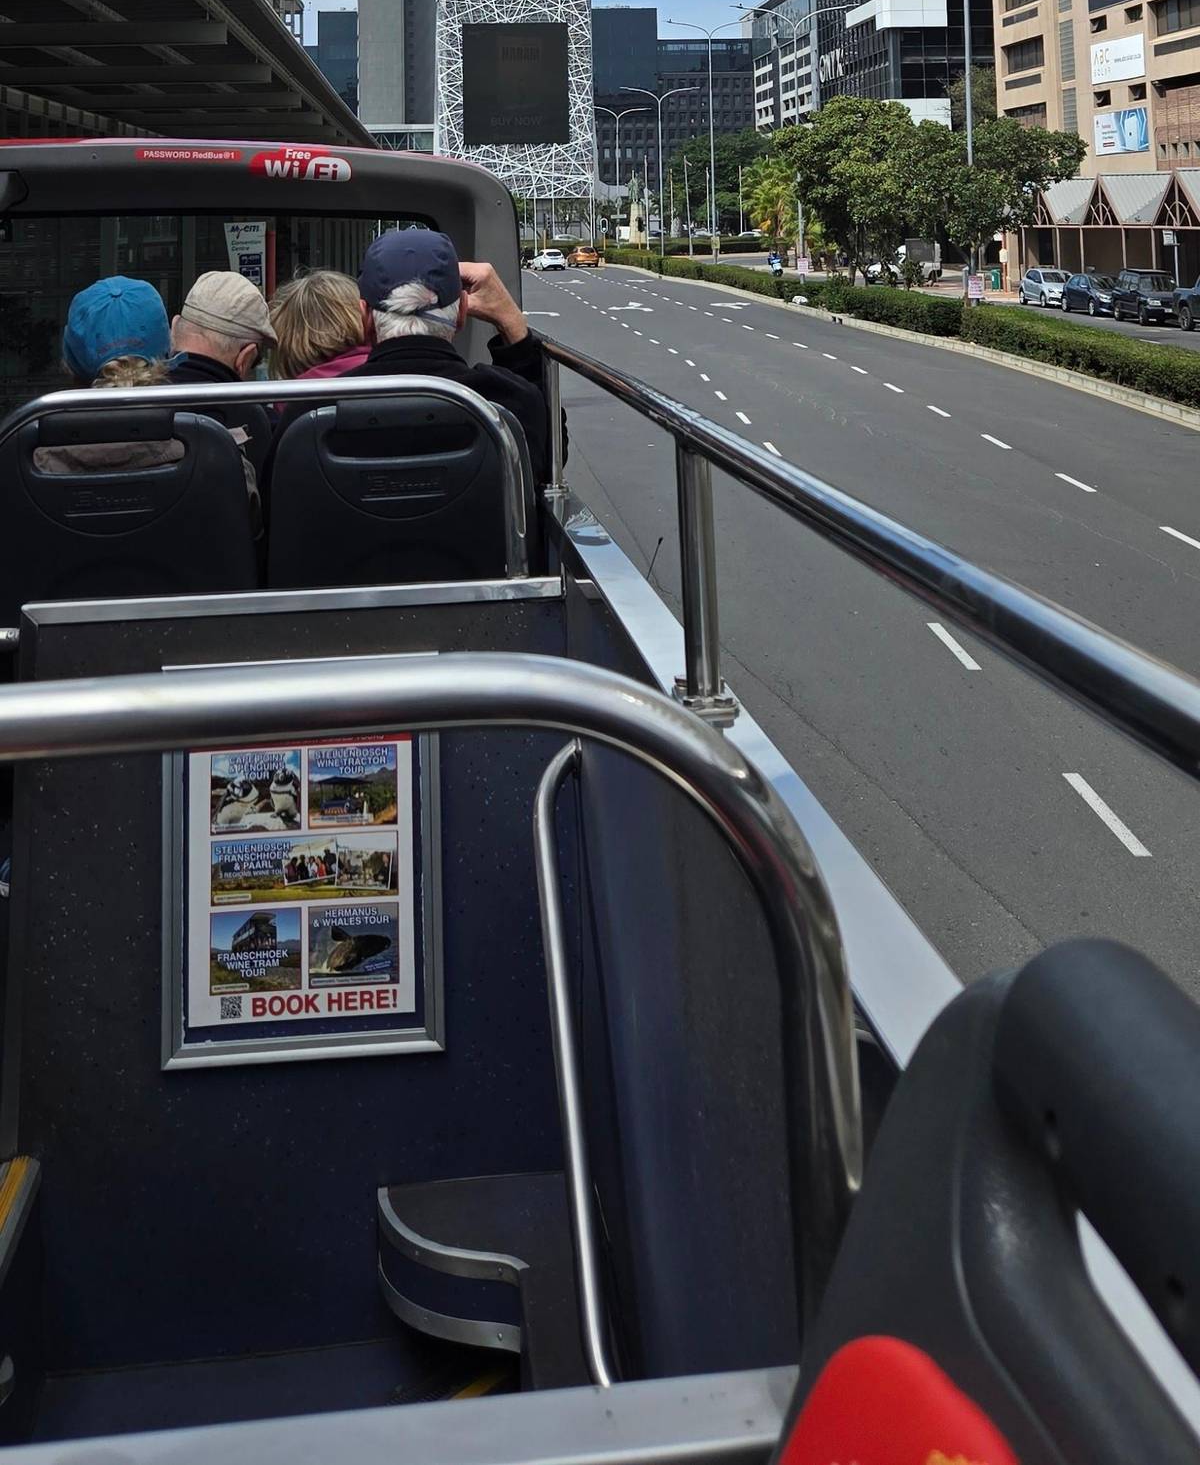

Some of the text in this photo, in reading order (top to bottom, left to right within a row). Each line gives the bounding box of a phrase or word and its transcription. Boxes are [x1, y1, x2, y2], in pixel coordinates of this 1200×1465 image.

[1094, 48, 1110, 66] ABC
[143, 150, 235, 159] PASSWORD RedBus@1
[285, 148, 311, 160] Free
[315, 747, 388, 759] STELLENBOSCH
[317, 756, 386, 768] WINE TRACTOR
[244, 771, 270, 781] TOUR
[339, 765, 366, 775] TOUR
[215, 842, 290, 855] STELLENBOSCH
[219, 850, 289, 863] FRANSCHHOEK
[233, 860, 273, 871] & PAARL
[325, 907, 377, 918] HERMANUS
[313, 915, 390, 928] & WHALES TOUR
[217, 949, 289, 962] FRANSCHHOEK
[226, 959, 280, 971] WINE TRAM
[240, 968, 266, 978] TOUR
[252, 988, 398, 1018] BOOK HERE!
